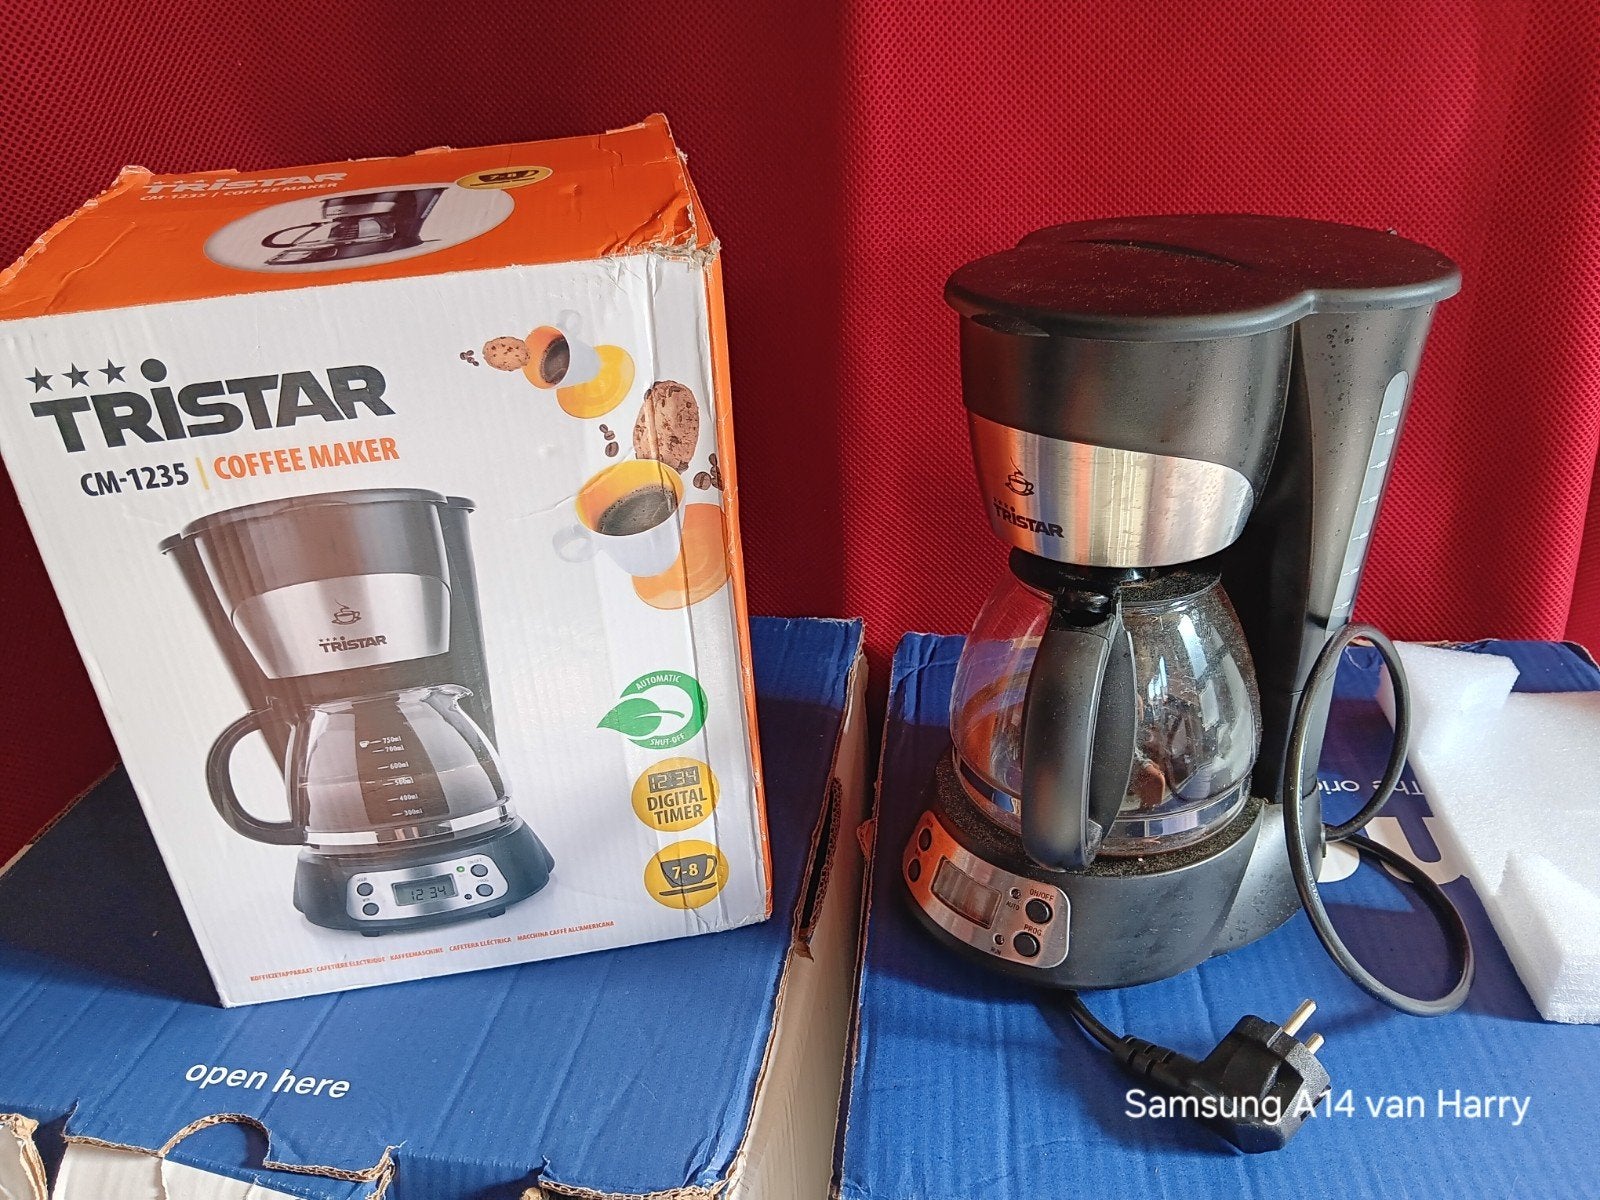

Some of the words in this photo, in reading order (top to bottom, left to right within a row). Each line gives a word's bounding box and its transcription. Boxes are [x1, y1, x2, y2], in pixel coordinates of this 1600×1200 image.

[224, 186, 283, 196] COFFEE
[284, 182, 338, 192] MAKER
[80, 462, 190, 497] CM-1235
[214, 447, 306, 480] COFFEE
[308, 437, 400, 469] MAKER
[635, 674, 681, 690] AUTOMATIC
[382, 736, 402, 744] 750ml
[649, 733, 685, 746] SHUT-OFF
[647, 787, 707, 811] DIGITAL
[654, 804, 703, 825] TIMER
[672, 863, 699, 880] 7-8
[1029, 888, 1054, 901] ON/OFF
[1006, 901, 1020, 911] AUTO
[1023, 924, 1042, 936] PROG
[449, 941, 479, 951] CAFETERA
[517, 931, 549, 941] MACCHINA
[185, 1064, 268, 1089] open
[272, 1068, 350, 1098] here
